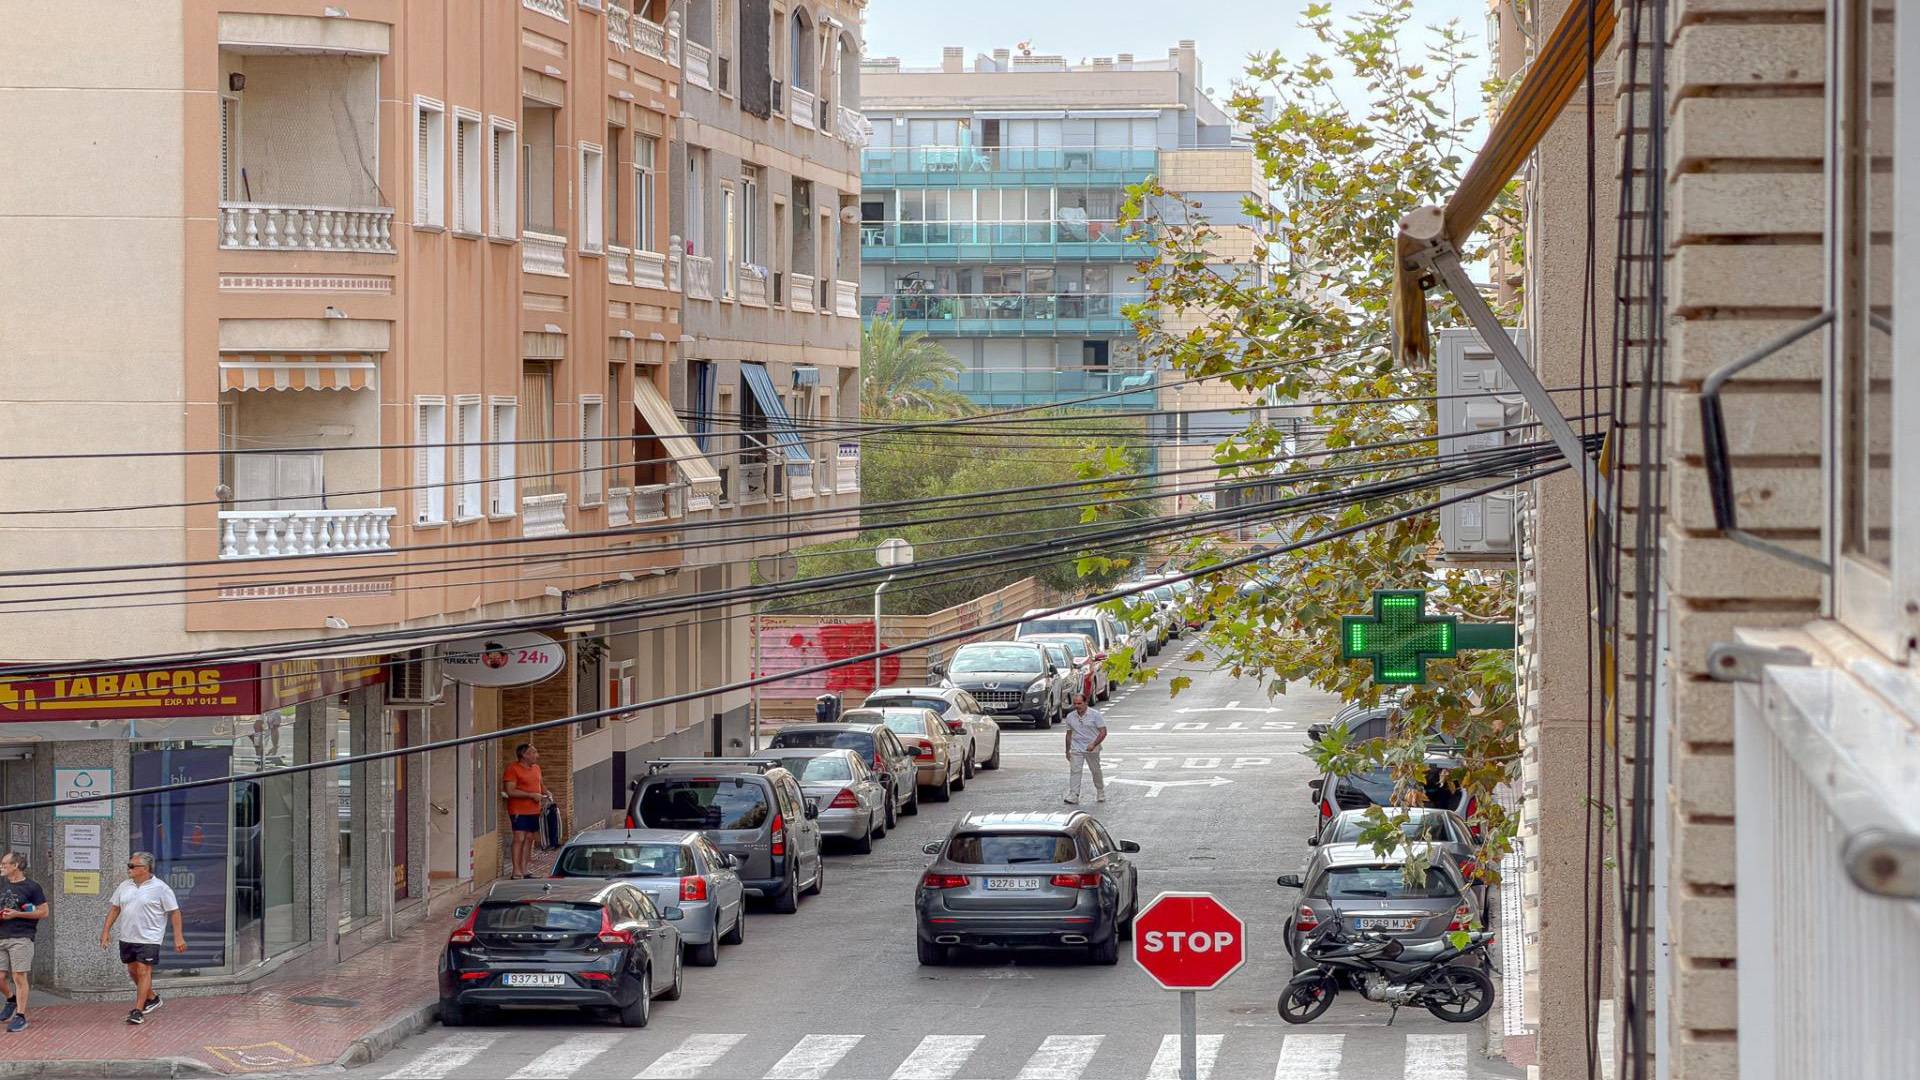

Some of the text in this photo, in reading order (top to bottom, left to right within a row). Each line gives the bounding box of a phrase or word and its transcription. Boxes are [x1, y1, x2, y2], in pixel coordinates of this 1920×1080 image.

[48, 669, 221, 698] TABACOS
[164, 698, 184, 706] EXP.
[200, 697, 218, 705] 012
[1083, 757, 1272, 769] STOP
[1018, 879, 1037, 888] LXR
[1144, 931, 1233, 953] STOP
[511, 974, 562, 984] 9373 LMY
